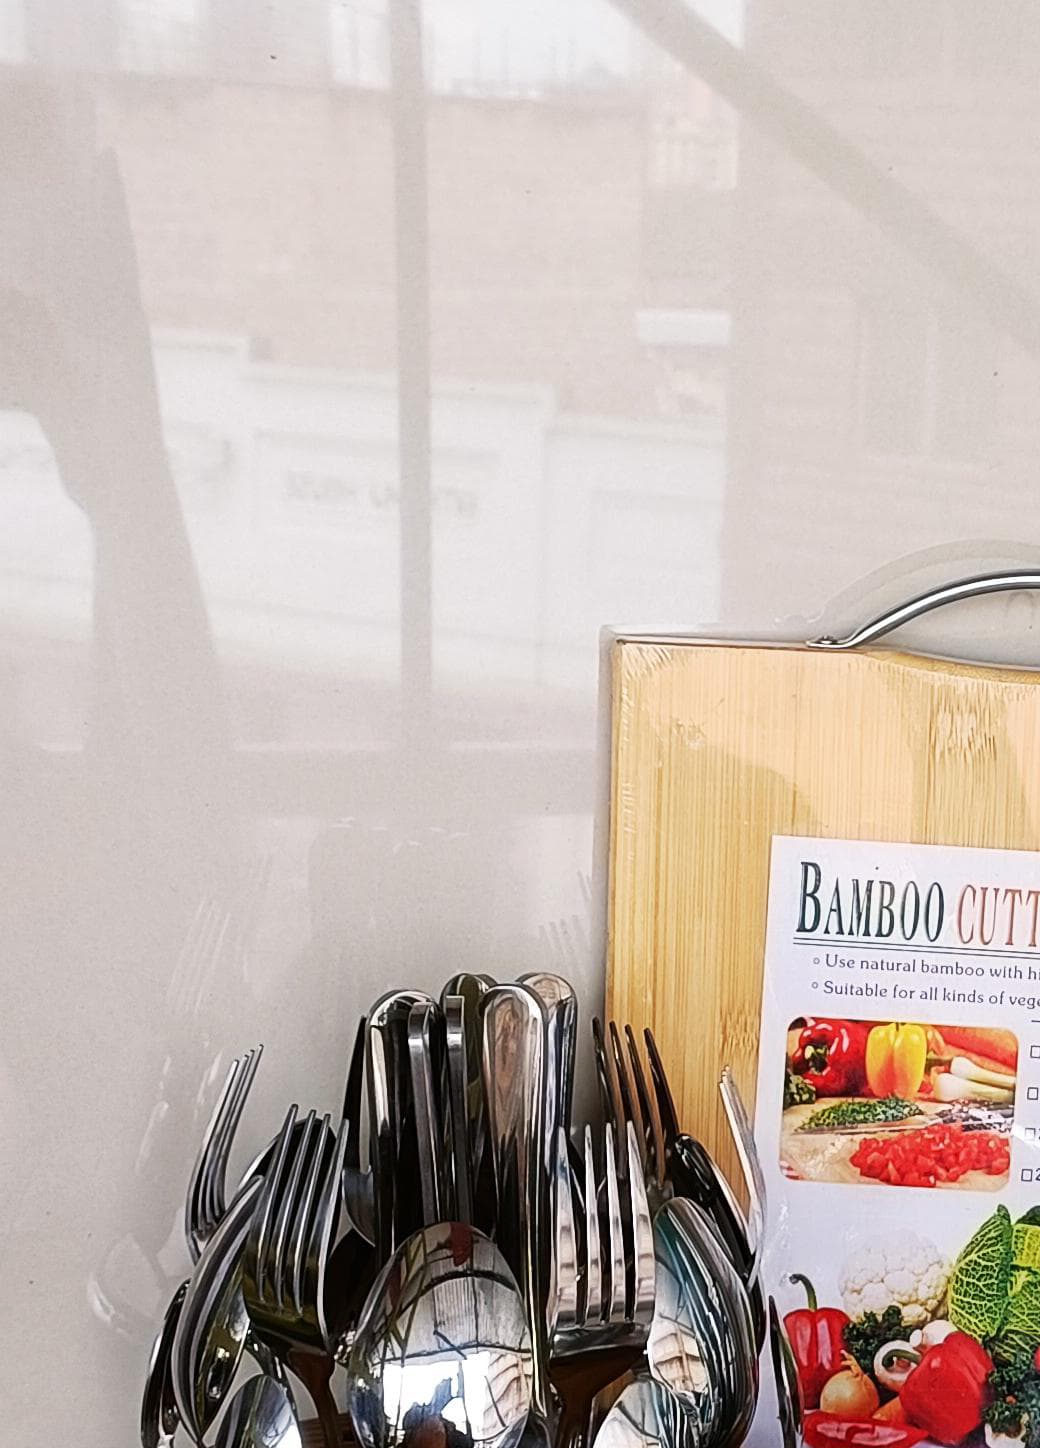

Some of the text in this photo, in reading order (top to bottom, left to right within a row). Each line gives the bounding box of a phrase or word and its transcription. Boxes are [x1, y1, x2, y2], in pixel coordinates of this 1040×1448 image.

[796, 861, 944, 942] BAMBOO
[825, 953, 856, 969] Use
[860, 958, 916, 974] natural
[920, 959, 985, 978] bamboo
[989, 964, 1023, 980] with
[823, 980, 888, 998] Suitable
[893, 984, 916, 1001] for
[919, 986, 938, 1001] all
[942, 987, 984, 1004] kinds
[988, 991, 1004, 1005] of
